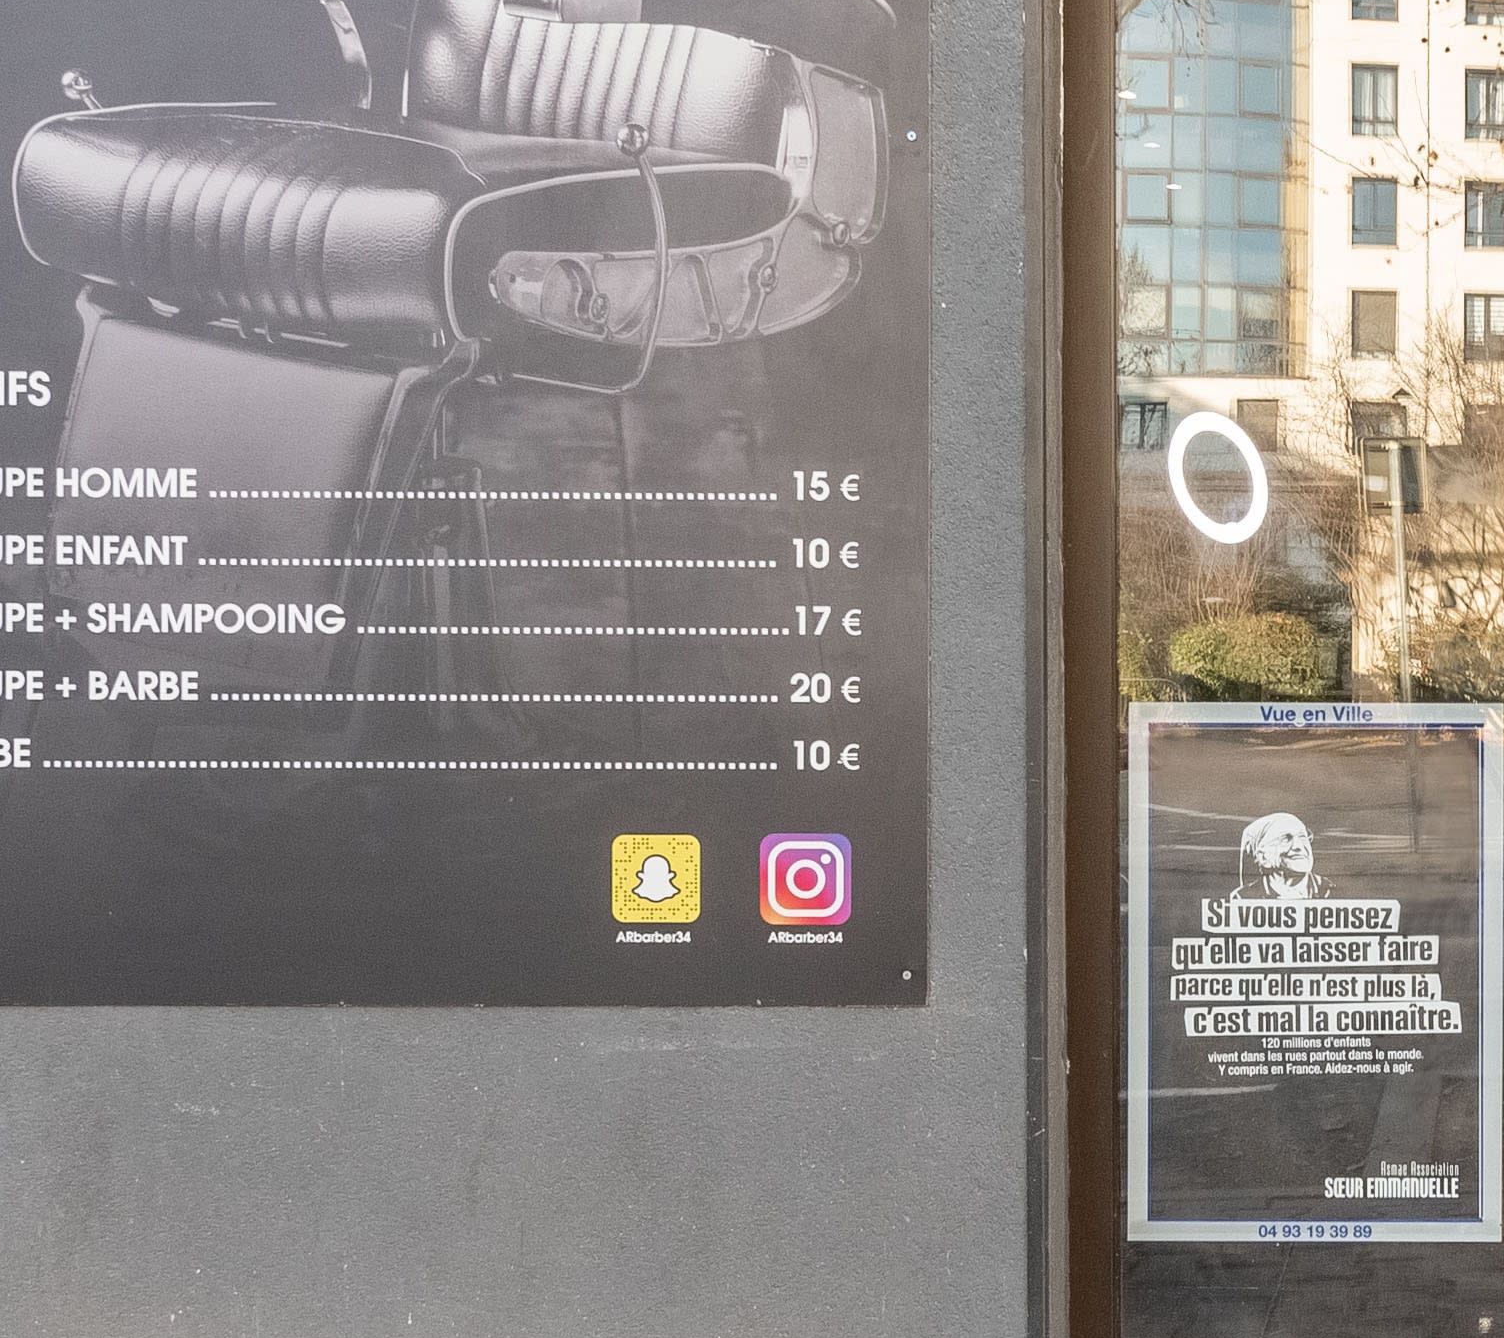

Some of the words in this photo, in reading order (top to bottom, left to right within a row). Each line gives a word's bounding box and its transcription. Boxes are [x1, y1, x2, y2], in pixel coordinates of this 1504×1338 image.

[56, 467, 197, 498] HOMME
[794, 471, 830, 501] 15
[840, 475, 859, 501] €
[56, 535, 188, 565] ENFANT
[793, 538, 829, 568] 10
[840, 542, 859, 568] €
[55, 609, 77, 630] +
[87, 603, 345, 634] SHAMPOOING
[796, 606, 831, 635] 17
[842, 609, 861, 635] €
[56, 677, 76, 697] +
[89, 671, 198, 700] BARBE
[791, 673, 831, 703] 20
[841, 677, 860, 703] €
[1258, 704, 1297, 722] Vue
[1302, 708, 1326, 722] en
[1332, 704, 1374, 722] Ville
[794, 740, 830, 770] 10
[837, 744, 860, 770] €
[1207, 900, 1231, 928] Si
[1238, 905, 1297, 928] vous
[1304, 906, 1393, 933] pensez
[616, 931, 691, 943] ARbarber34
[768, 932, 843, 943] ARbarber34
[1175, 937, 1252, 968] qu'elle
[1258, 942, 1285, 964] va
[1292, 935, 1372, 964] laisser
[1378, 935, 1433, 963] faire
[1175, 976, 1232, 1000] parce
[1238, 973, 1303, 1001] qu'elle
[1309, 974, 1358, 998] n'est
[1364, 975, 1406, 1002] plus
[1412, 974, 1435, 1000] là,
[1193, 1007, 1251, 1034] c'est
[1257, 1004, 1301, 1034] mal
[1308, 1005, 1329, 1033] la
[1336, 1002, 1459, 1033] connaître.
[1207, 1052, 1238, 1063] vivent
[1241, 1051, 1265, 1062] dans
[1267, 1050, 1282, 1062] les
[1284, 1052, 1307, 1062] rues
[1309, 1049, 1346, 1063] partout
[1348, 1049, 1373, 1061] dans
[1376, 1049, 1385, 1060] le
[1387, 1048, 1424, 1061] monde.
[1261, 1038, 1280, 1049] 120
[1282, 1037, 1322, 1049] millions
[1324, 1037, 1372, 1049] d'enfants
[1218, 1065, 1227, 1076] Y
[1228, 1064, 1269, 1077] compris
[1271, 1066, 1284, 1075] en
[1286, 1063, 1323, 1075] France.
[1325, 1061, 1381, 1075] Aidez-nous
[1383, 1061, 1391, 1073] à
[1392, 1062, 1414, 1076] agir.
[1410, 1161, 1460, 1177] Association
[1324, 1177, 1364, 1199] SŒUR
[1366, 1177, 1459, 1199] EMMANUELLE
[1258, 1225, 1277, 1238] 04
[1282, 1225, 1301, 1238] 93
[1307, 1225, 1325, 1238] 19
[1329, 1225, 1348, 1238] 39
[1353, 1225, 1372, 1238] 89
